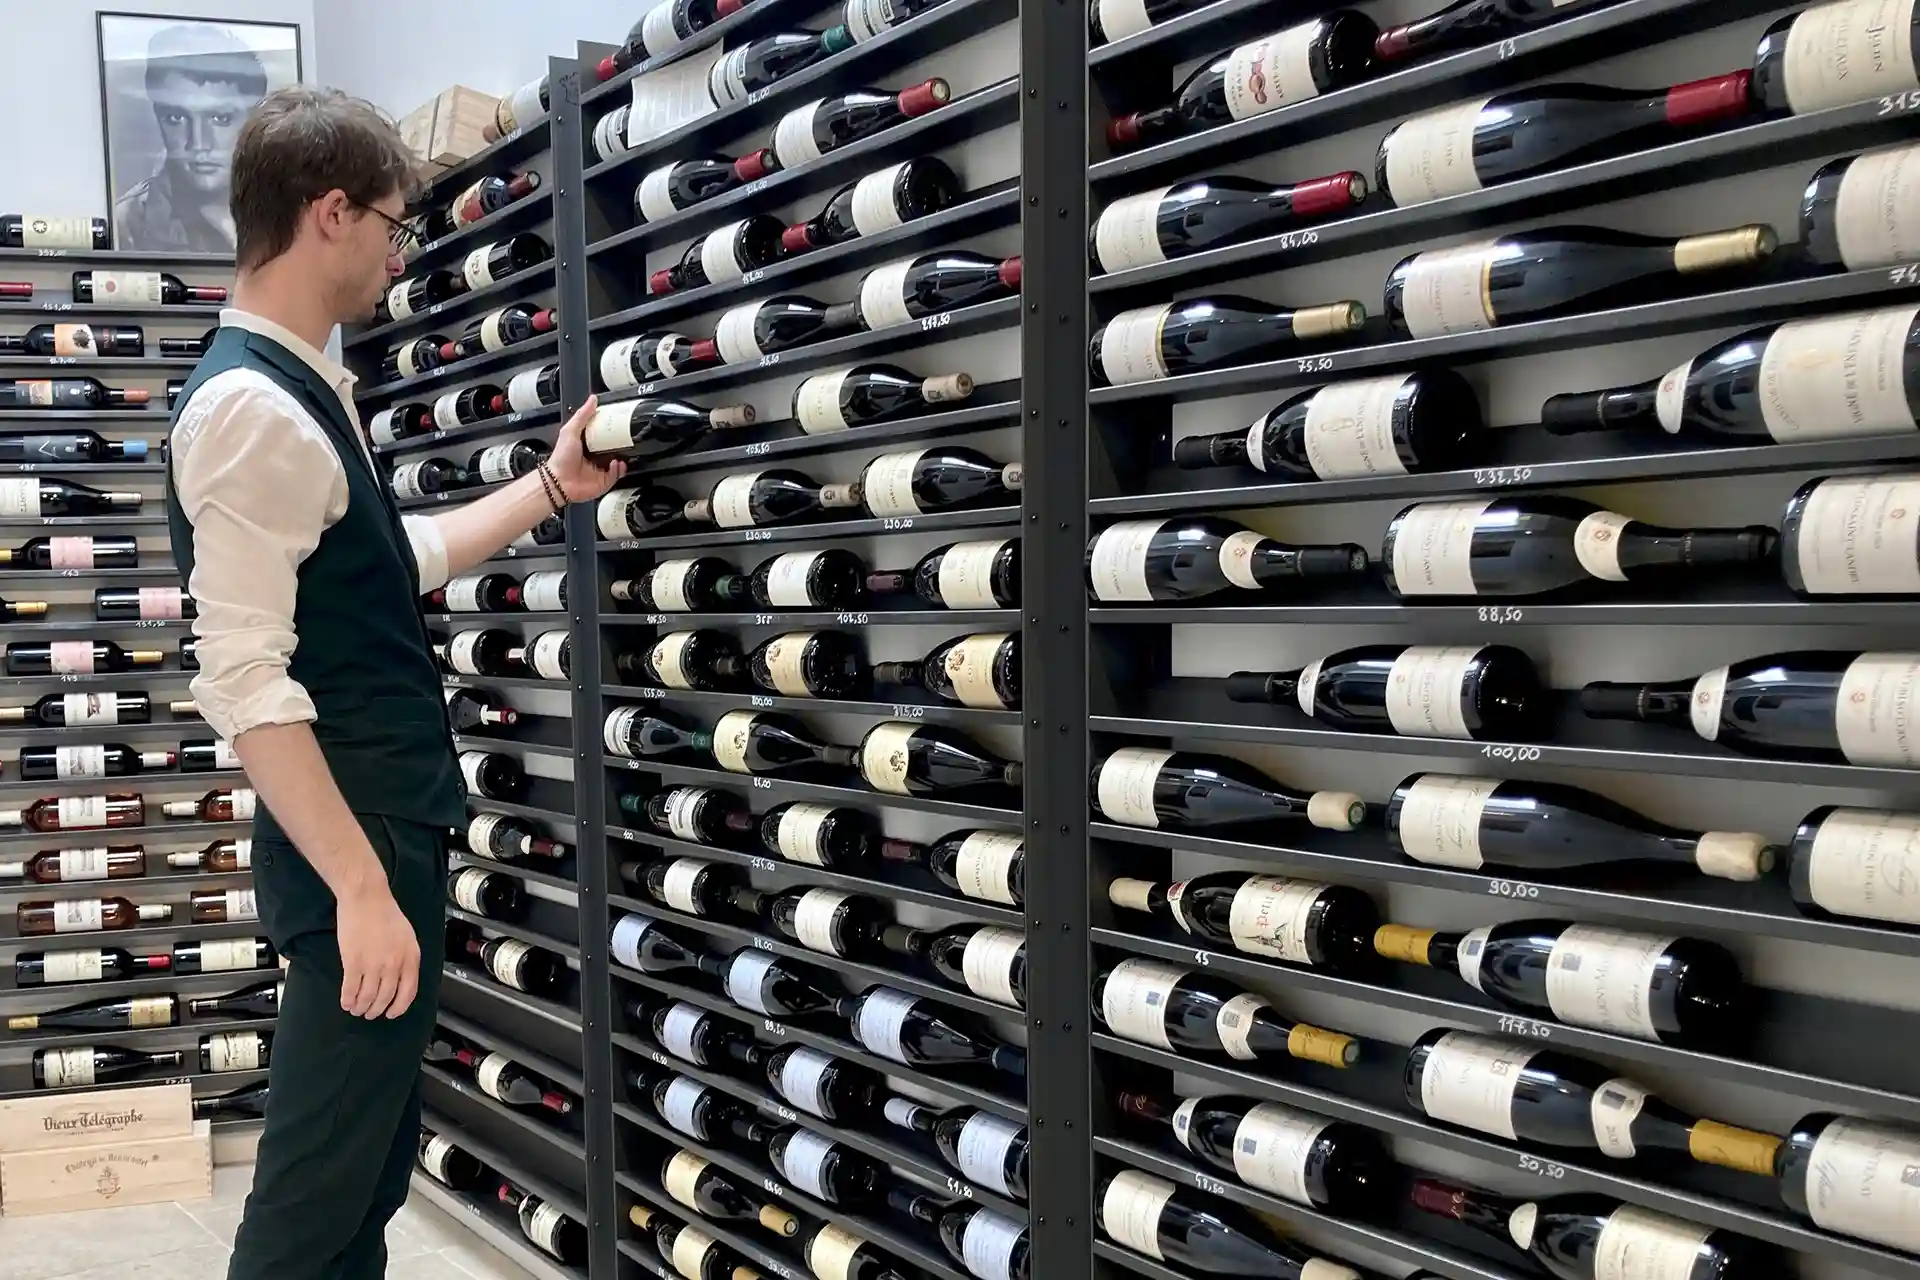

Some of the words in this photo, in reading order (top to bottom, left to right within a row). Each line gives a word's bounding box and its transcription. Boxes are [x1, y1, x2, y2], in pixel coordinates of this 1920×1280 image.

[1280, 231, 1319, 250] 84,00
[1297, 357, 1333, 373] 75,50
[884, 519, 913, 530] 230,00
[1477, 607, 1522, 625] 88,50
[1481, 745, 1541, 762] 100,00
[1488, 880, 1539, 898] 90,00
[1498, 1015, 1551, 1037] 117,50
[41, 1116, 77, 1131] Vieux
[78, 1108, 143, 1128] Télégraphe
[1518, 1154, 1564, 1179] 50,50
